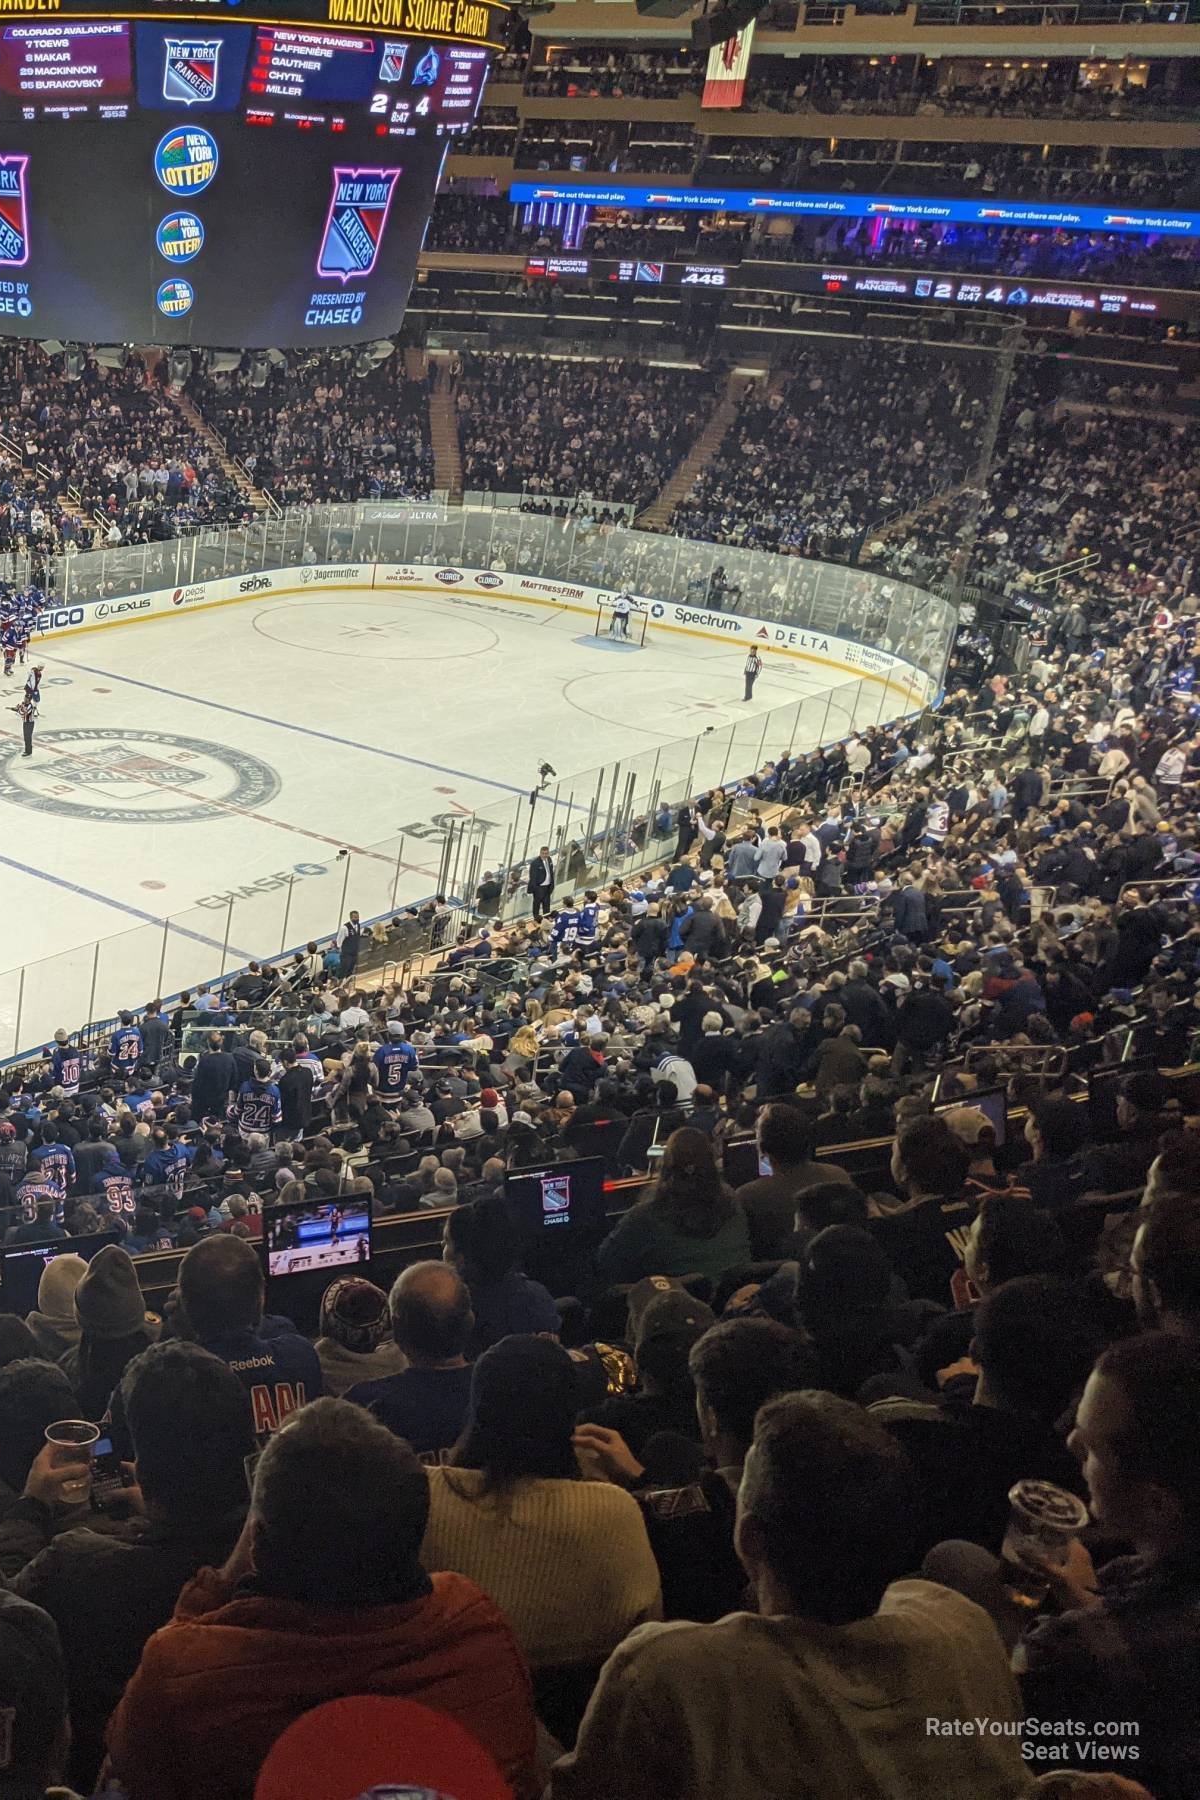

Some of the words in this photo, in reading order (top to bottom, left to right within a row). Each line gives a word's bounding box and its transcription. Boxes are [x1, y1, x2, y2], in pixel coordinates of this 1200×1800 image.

[328, 0, 402, 27] MADISON
[405, 0, 454, 32] SQUARE
[454, 1, 490, 37] GARDEN
[12, 28, 62, 37] COLORADO
[63, 25, 123, 35] AVALANCHE
[34, 39, 69, 48] TOEWS
[274, 31, 297, 40] NEW
[297, 34, 322, 44] YORK
[323, 37, 364, 49] RANGERS
[34, 53, 71, 62] MAKAR
[170, 47, 189, 57] NEW
[192, 47, 215, 58] YORK
[271, 57, 321, 70] GAUTHIER
[20, 67, 34, 76] 29
[35, 66, 97, 76] MACKINNON
[268, 71, 304, 82] CHYTIL
[35, 79, 103, 89] BURAKOVSKY
[175, 61, 212, 96] RANGERS
[266, 84, 302, 96] MILLER
[370, 94, 388, 113] 2
[415, 96, 430, 116] 4
[391, 112, 409, 123] 8:47
[186, 134, 208, 146] NEW
[188, 146, 213, 162] YORK
[161, 160, 215, 186] LOTTERY
[337, 183, 359, 201] NEW
[362, 183, 389, 201] YORK
[699, 196, 725, 204] Lottery
[795, 200, 813, 208] there
[924, 207, 951, 215] Lottery
[1025, 211, 1042, 220] there
[1042, 213, 1059, 221] and
[179, 217, 196, 226] NEW
[1125, 216, 1143, 225] New
[1144, 217, 1164, 226] York
[1165, 218, 1191, 229] Lottery
[181, 226, 200, 239] YORK
[340, 208, 373, 265] RANGERS
[161, 236, 202, 256] LOTTERY
[548, 265, 587, 273] PELICANS
[550, 259, 588, 267] NUGGETS
[686, 266, 725, 274] FACEOFFS
[681, 273, 725, 285] .448
[16, 283, 28, 294] BY
[855, 282, 906, 293] RANGERS
[934, 284, 952, 298] 2
[310, 292, 353, 305] PRESENTED
[355, 291, 366, 304] BY
[957, 291, 981, 301] 8:47
[985, 288, 1003, 302] 4
[1031, 295, 1095, 308] AVALANCHE
[1100, 293, 1127, 302] SHOTS
[1102, 303, 1120, 312] 25
[304, 309, 350, 325] CHASE
[185, 584, 206, 599] pepsi
[110, 599, 150, 614] LEXUS
[674, 607, 737, 632] Spectrum
[775, 629, 829, 652] DELTA
[861, 648, 895, 667] Northwell
[859, 657, 881, 672] Health
[41, 729, 177, 744] RANGERS
[89, 808, 192, 819] MADISON
[195, 871, 304, 910] CHASE
[119, 1041, 138, 1060] 24
[62, 1064, 79, 1085] 10
[388, 1063, 402, 1085] 5
[241, 1102, 271, 1128] 24
[106, 1185, 136, 1213] 93
[230, 1355, 275, 1372] Reebok
